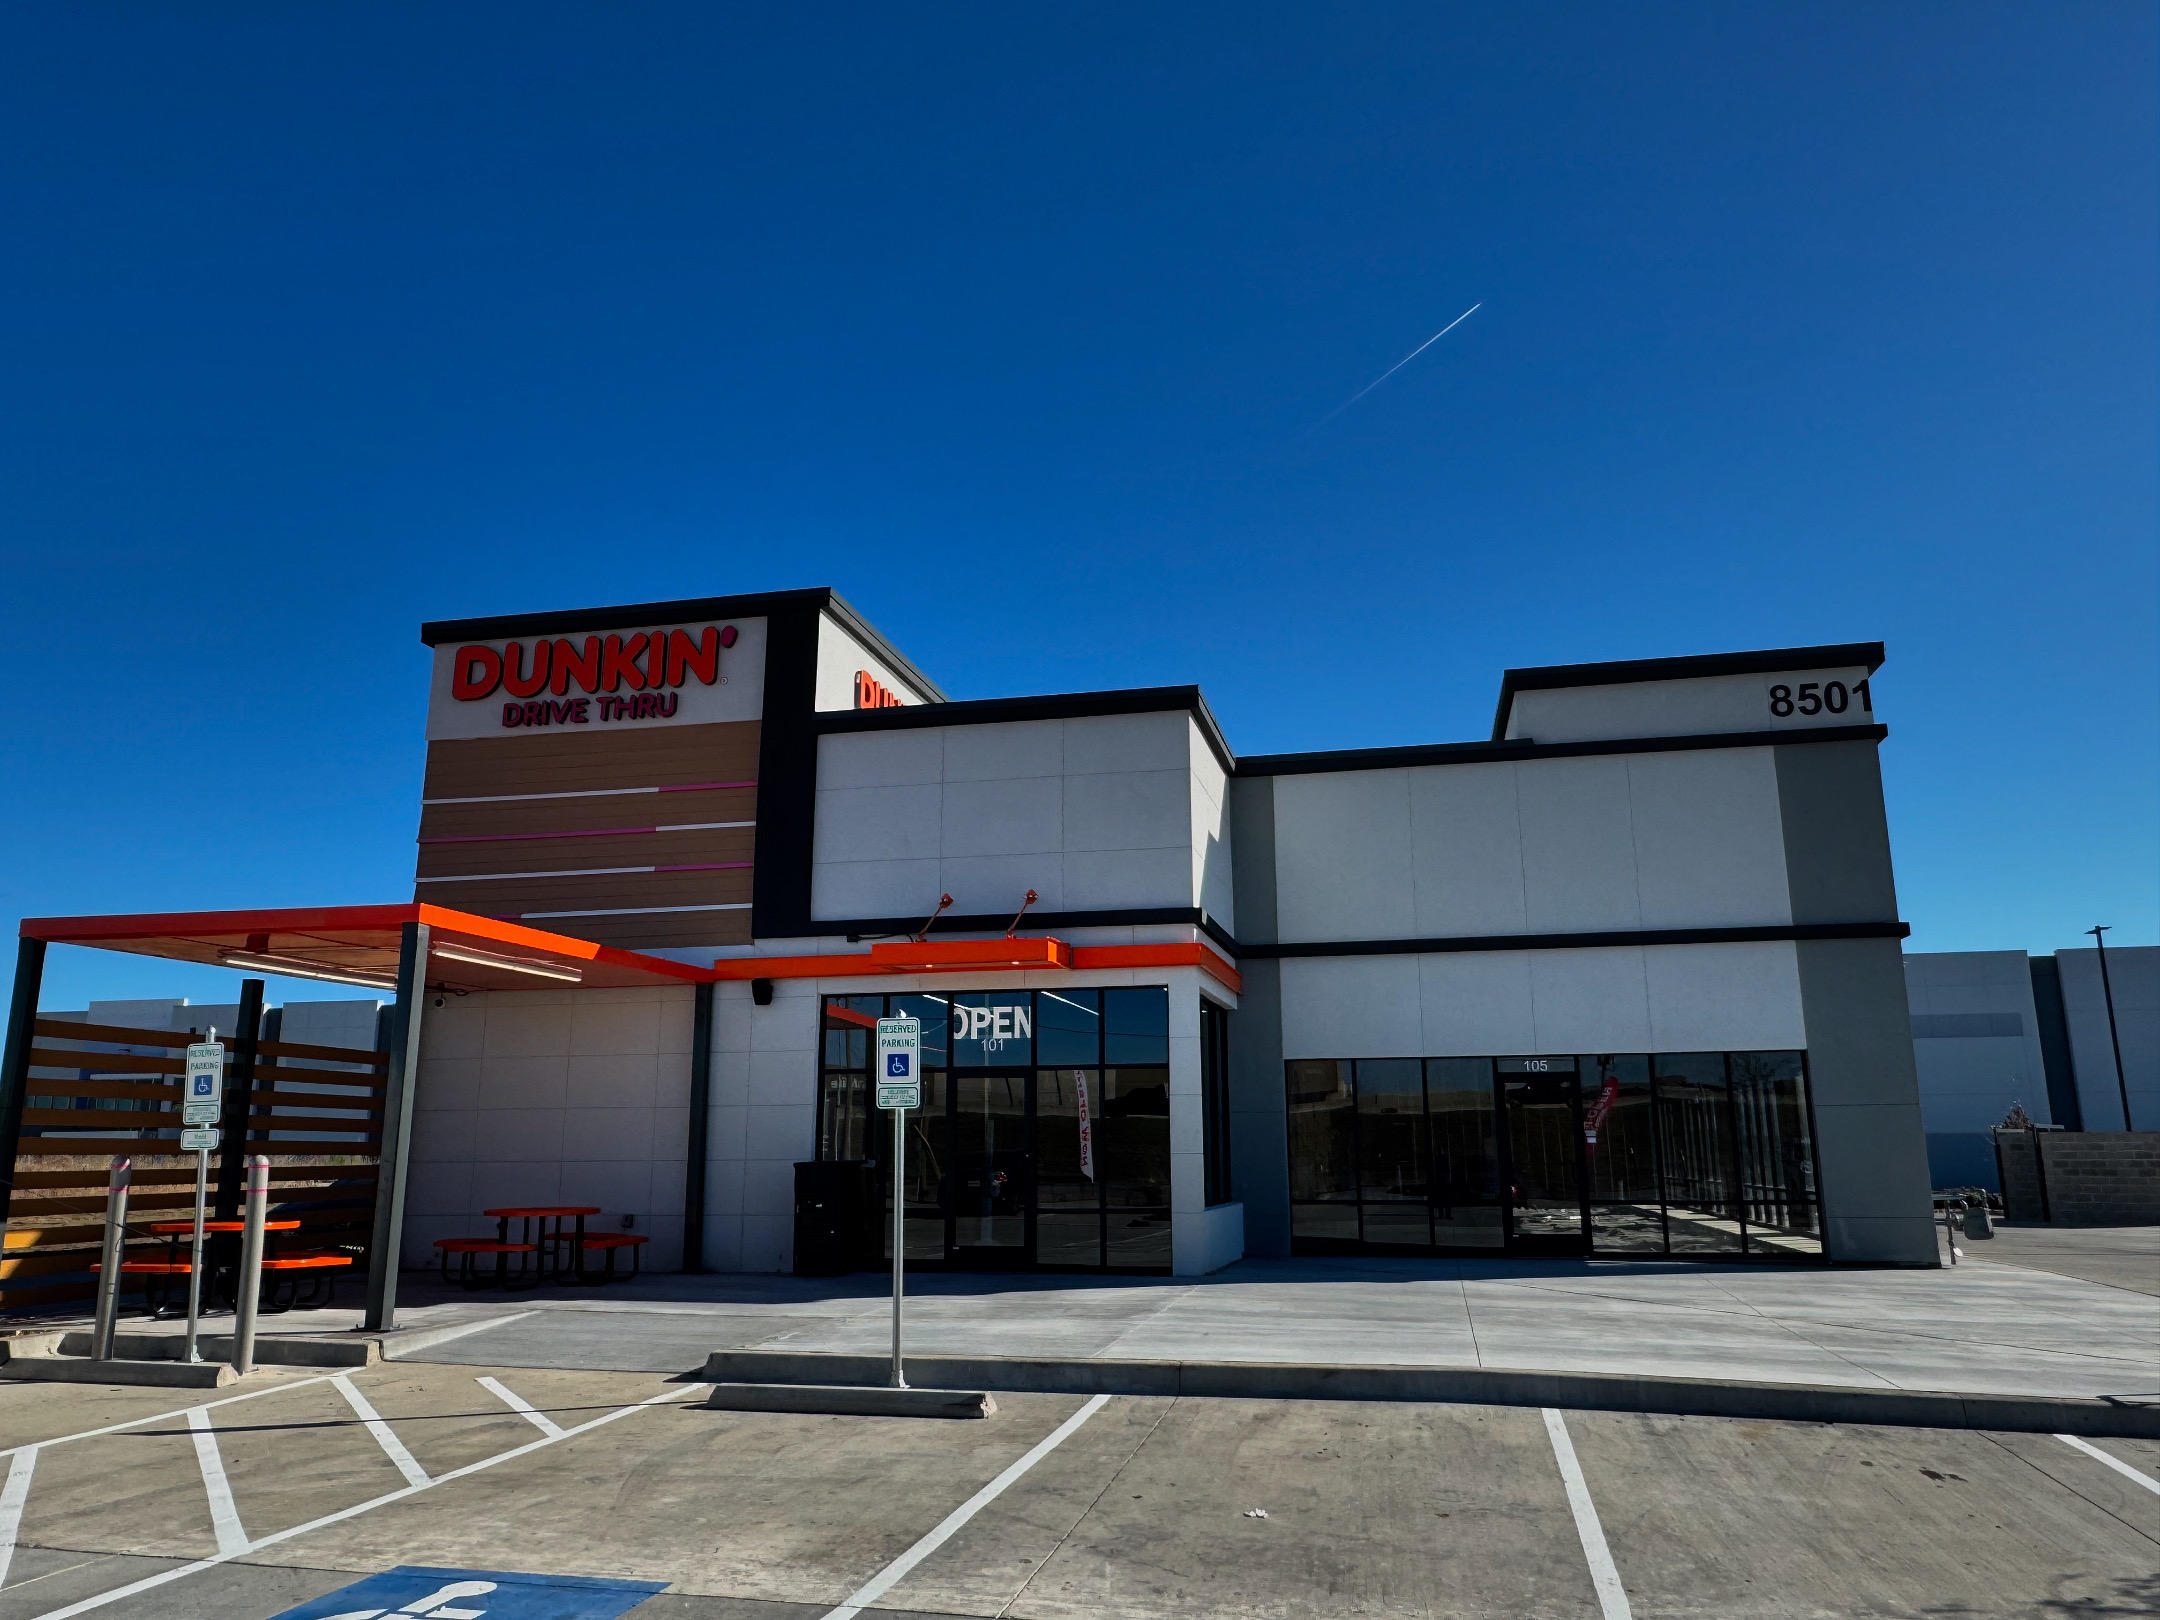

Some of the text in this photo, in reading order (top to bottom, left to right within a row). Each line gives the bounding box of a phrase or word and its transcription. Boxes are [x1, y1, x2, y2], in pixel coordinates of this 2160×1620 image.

[452, 626, 738, 701] DUNKIN'
[1769, 679, 1872, 717] 8501
[502, 692, 678, 728] DRIVE THRU
[880, 1025, 916, 1033] RESERVED
[881, 1039, 915, 1047] PARKING
[981, 1039, 1004, 1051] 101
[190, 1062, 219, 1071] PARKING
[1523, 1060, 1548, 1071] 105
